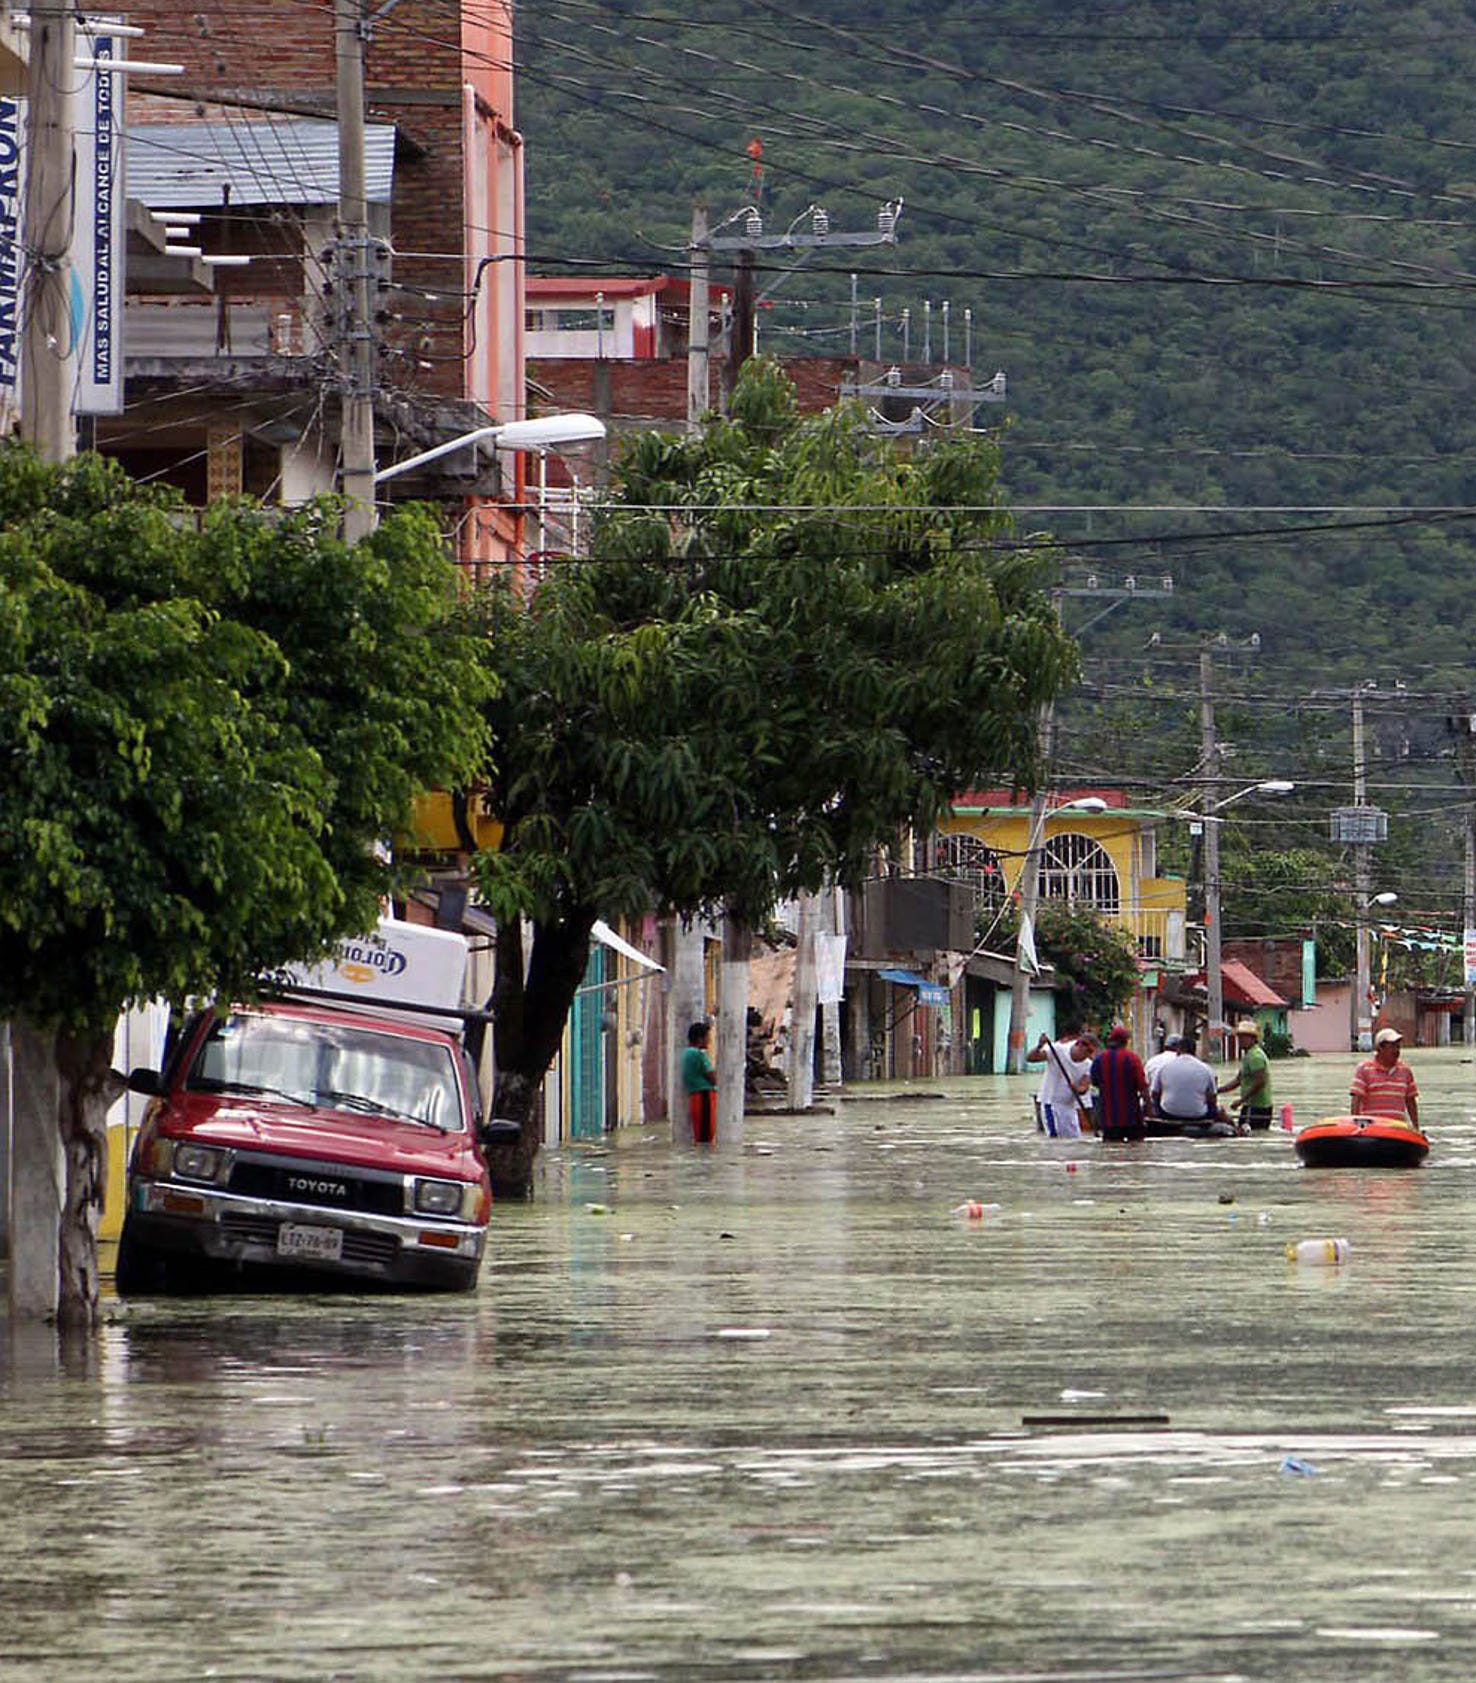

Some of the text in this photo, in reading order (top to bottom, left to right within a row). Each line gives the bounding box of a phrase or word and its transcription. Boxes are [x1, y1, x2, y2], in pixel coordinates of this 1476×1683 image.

[98, 49, 110, 114] TODS
[98, 119, 110, 143] DE
[97, 338, 109, 378] MAS
[288, 1177, 347, 1197] TOYOTA
